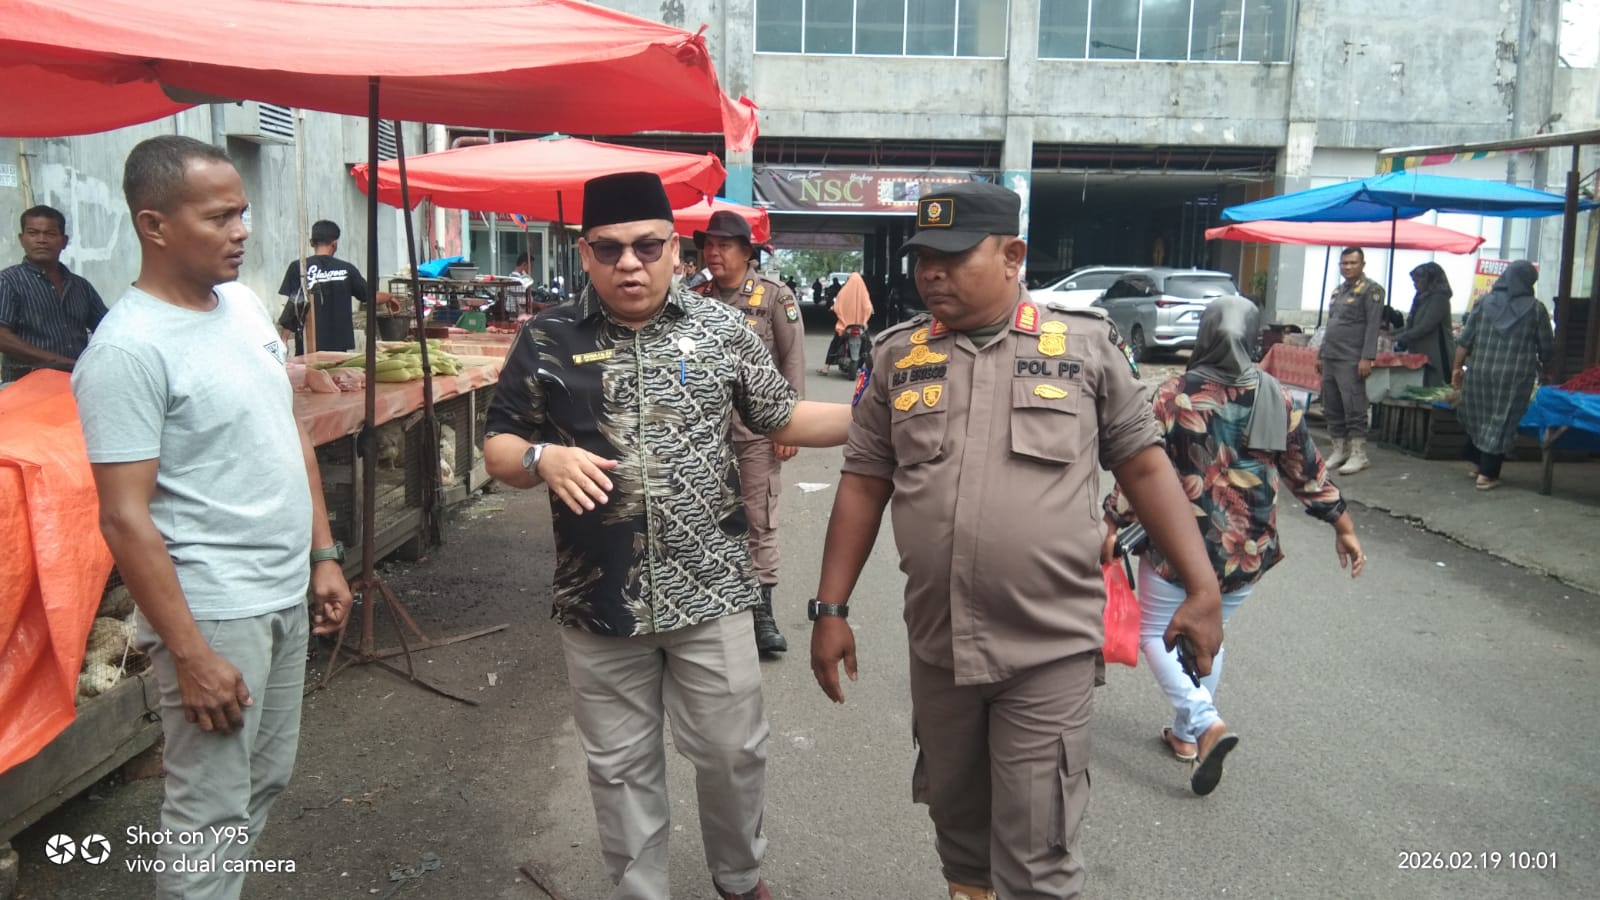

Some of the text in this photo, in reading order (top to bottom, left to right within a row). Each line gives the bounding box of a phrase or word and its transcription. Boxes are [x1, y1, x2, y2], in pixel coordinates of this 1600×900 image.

[799, 179, 864, 201] NSC
[1017, 360, 1081, 379] POL PP
